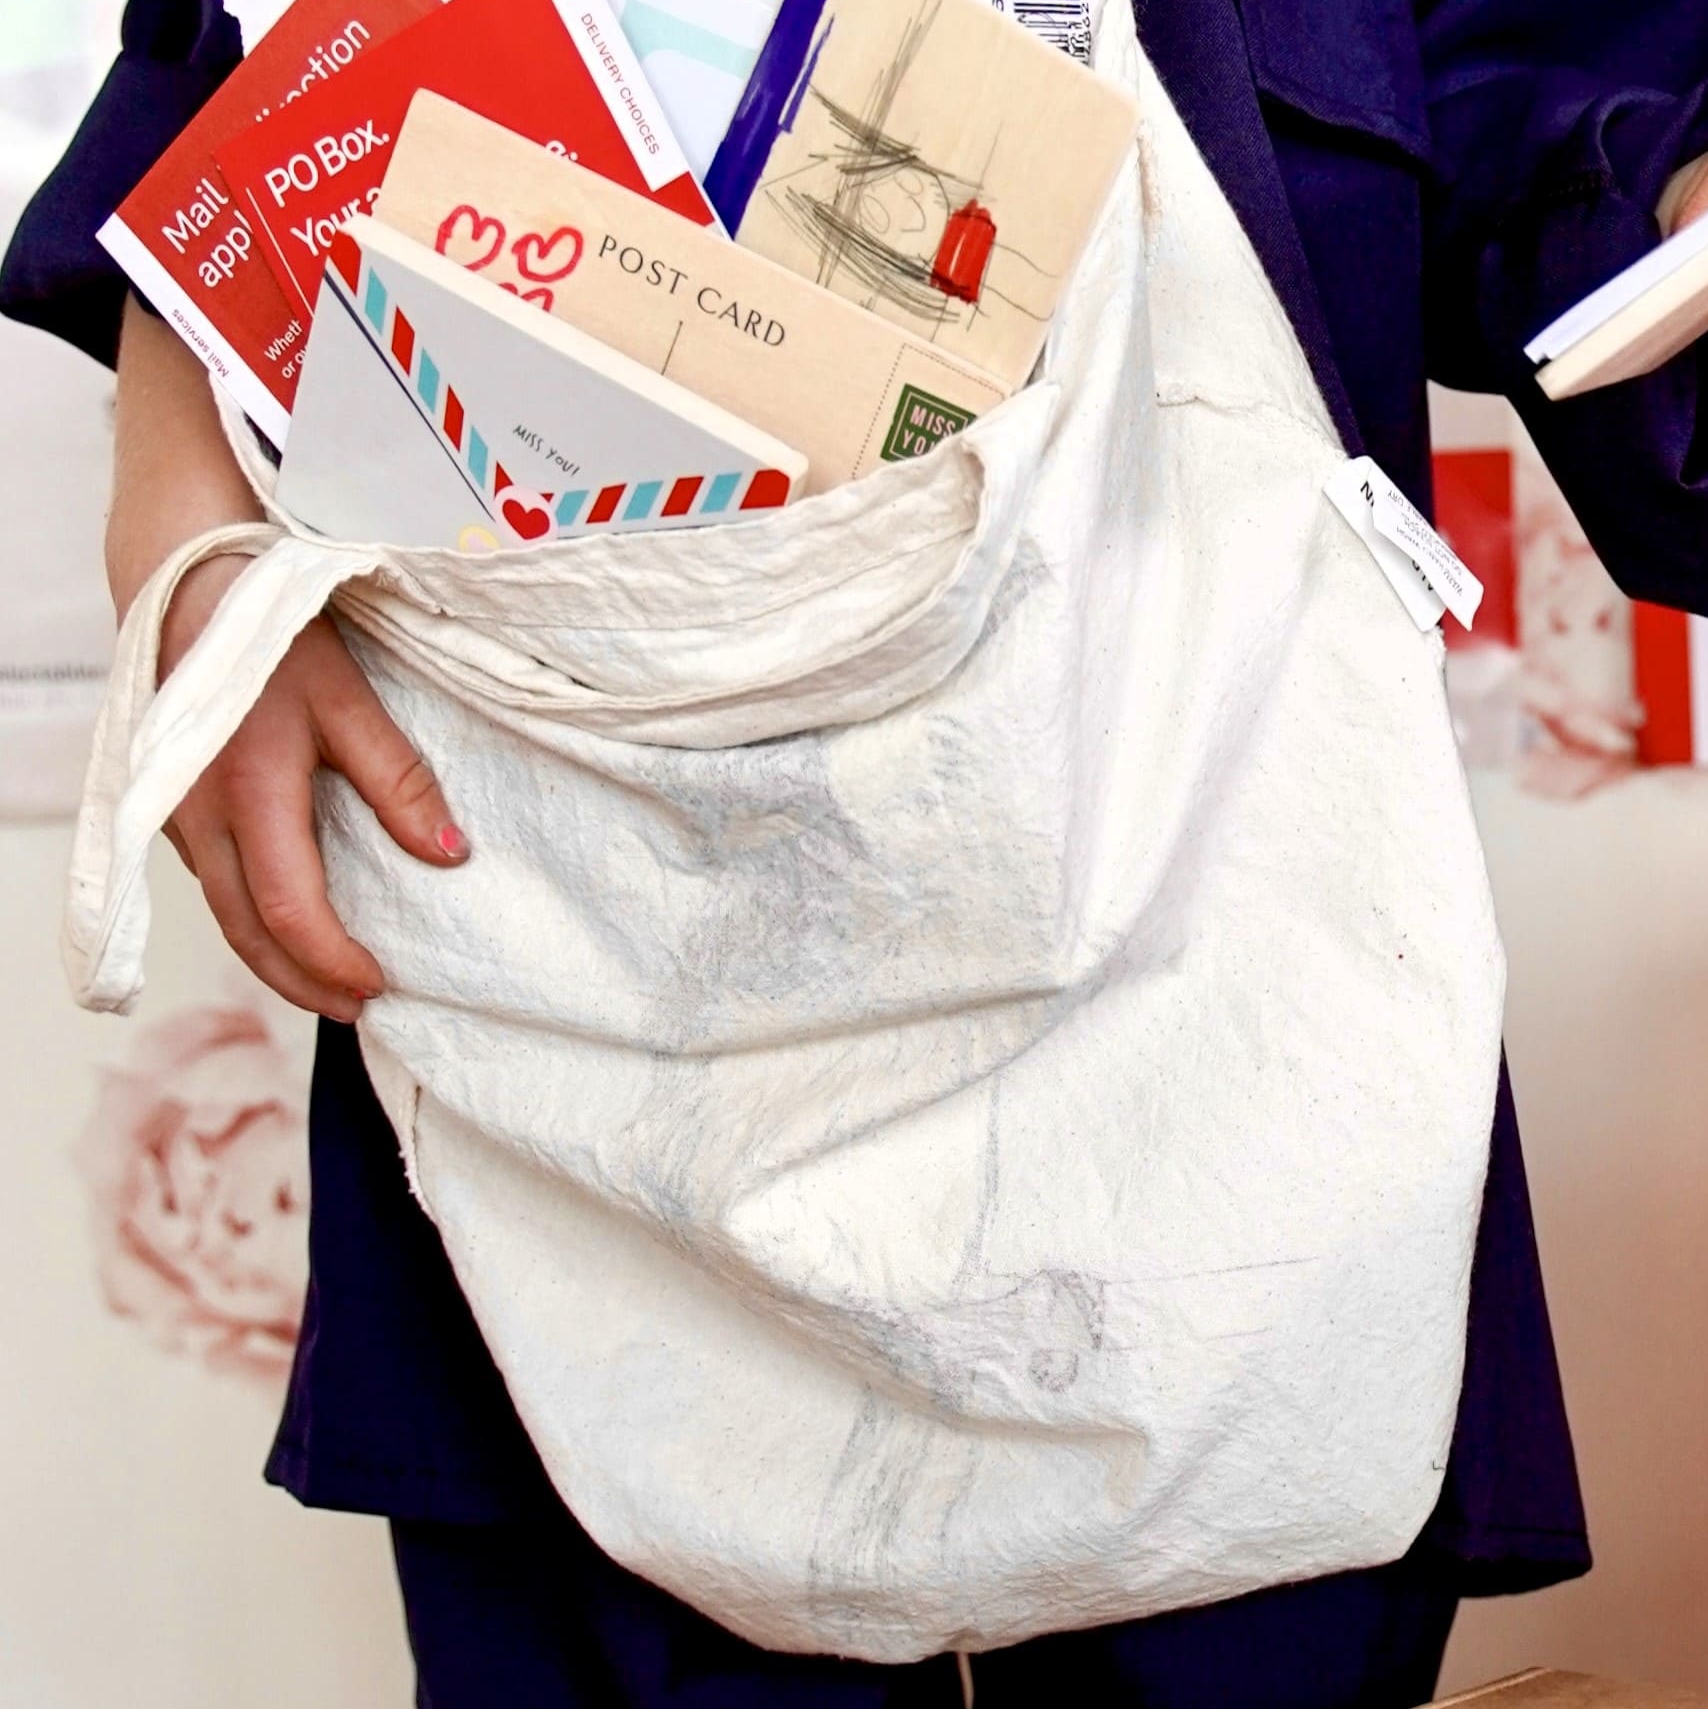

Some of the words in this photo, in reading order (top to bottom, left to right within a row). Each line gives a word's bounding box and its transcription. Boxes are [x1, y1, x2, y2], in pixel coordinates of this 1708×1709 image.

[580, 12, 625, 84] DELIVERY
[619, 86, 660, 155] CHOICES
[264, 153, 319, 209] PO
[313, 119, 391, 178] Box.
[161, 178, 229, 255] Mail
[598, 234, 689, 295] POST
[697, 286, 786, 347] CARD
[171, 308, 211, 354] services
[207, 352, 231, 379] Mail
[281, 360, 297, 379] or
[910, 404, 957, 437] MISS
[512, 424, 544, 453] MISS
[545, 447, 580, 477] YOU!
